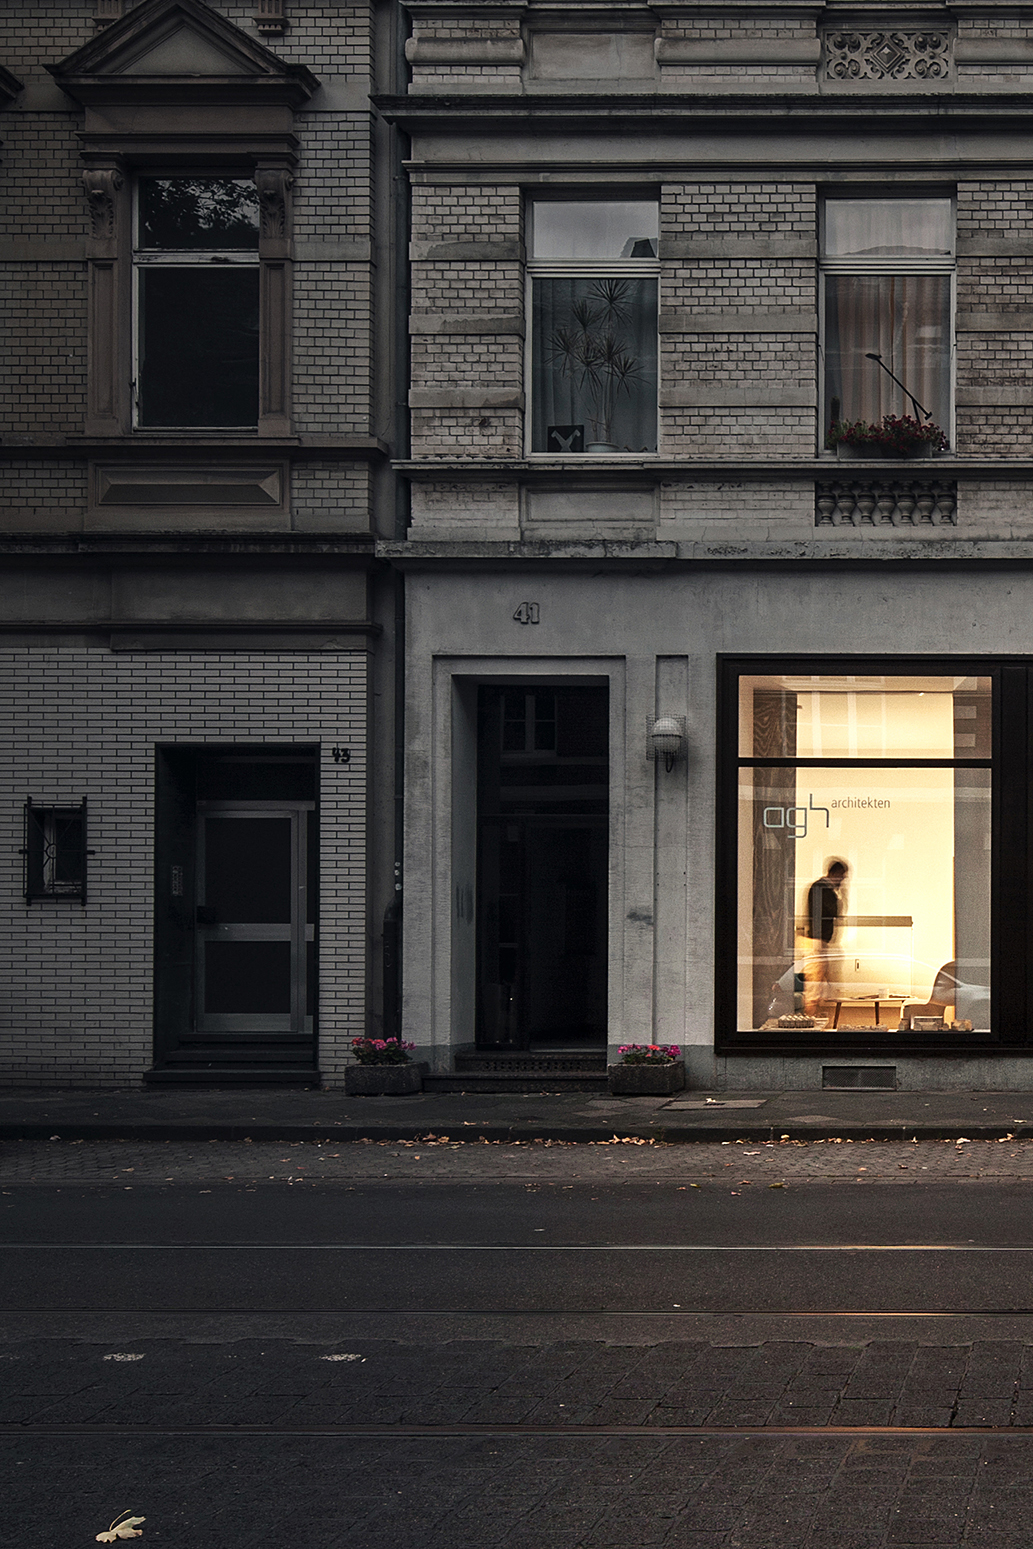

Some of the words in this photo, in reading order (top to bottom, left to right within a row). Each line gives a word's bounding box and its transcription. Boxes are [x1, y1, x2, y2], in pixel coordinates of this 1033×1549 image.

[512, 601, 540, 625] 41
[332, 747, 350, 763] 43
[763, 793, 829, 838] agh
[831, 796, 891, 809] architekten
